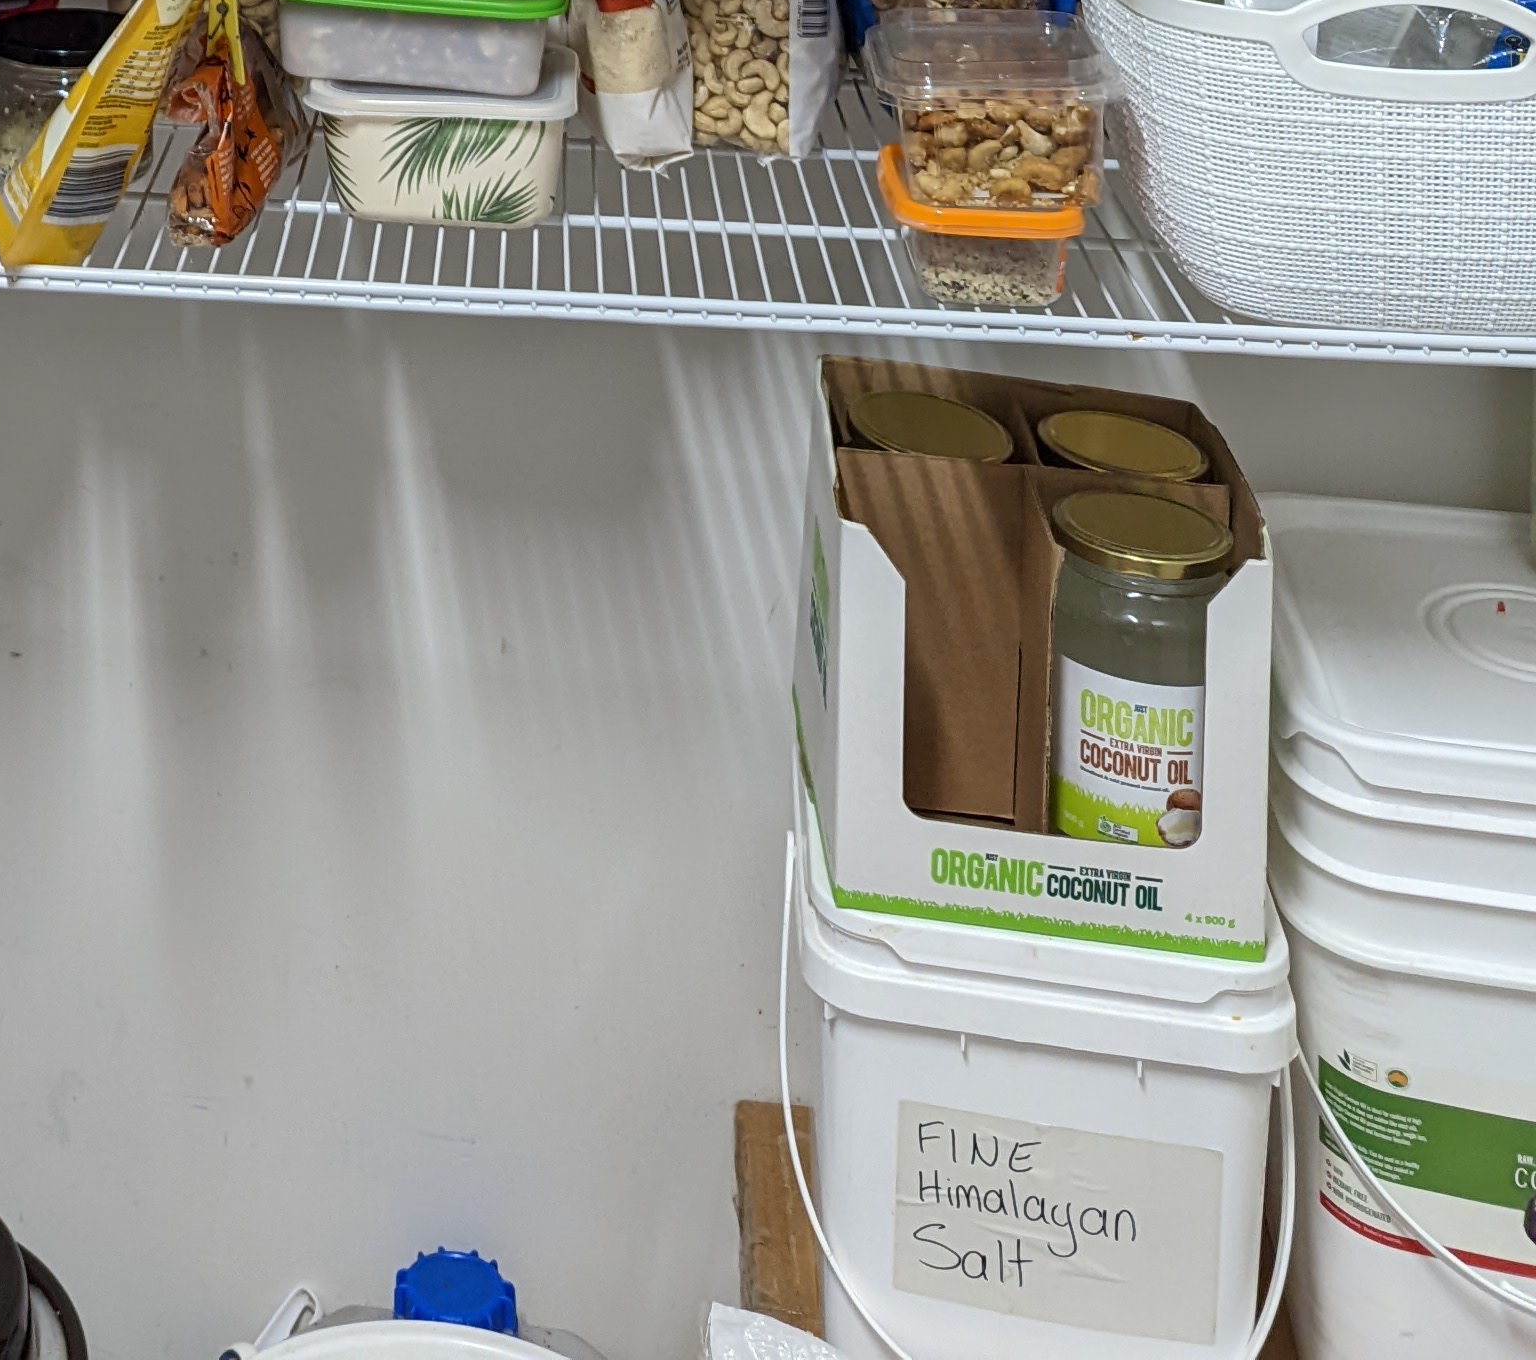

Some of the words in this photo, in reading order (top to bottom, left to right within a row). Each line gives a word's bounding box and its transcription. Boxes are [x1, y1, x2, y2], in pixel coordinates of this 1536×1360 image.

[1080, 688, 1195, 748] ORGANIC
[1080, 738, 1162, 784] COCONUT
[1167, 759, 1194, 786] OIL
[1110, 737, 1136, 754] EXTRA
[1137, 743, 1163, 757] VIRGIN
[930, 847, 1045, 898] ORGANIC
[1046, 873, 1130, 908] COCONUT
[1135, 884, 1163, 912] OIL
[1079, 866, 1104, 879] EXTRA
[1106, 868, 1132, 881] VIRGIN
[1185, 912, 1194, 923] 4
[1195, 915, 1203, 924] x
[1205, 915, 1226, 927] 900
[1228, 918, 1237, 930] g
[917, 1120, 1043, 1174] FINE
[918, 1170, 1138, 1259] Himalayan
[913, 1224, 1034, 1288] Salt
